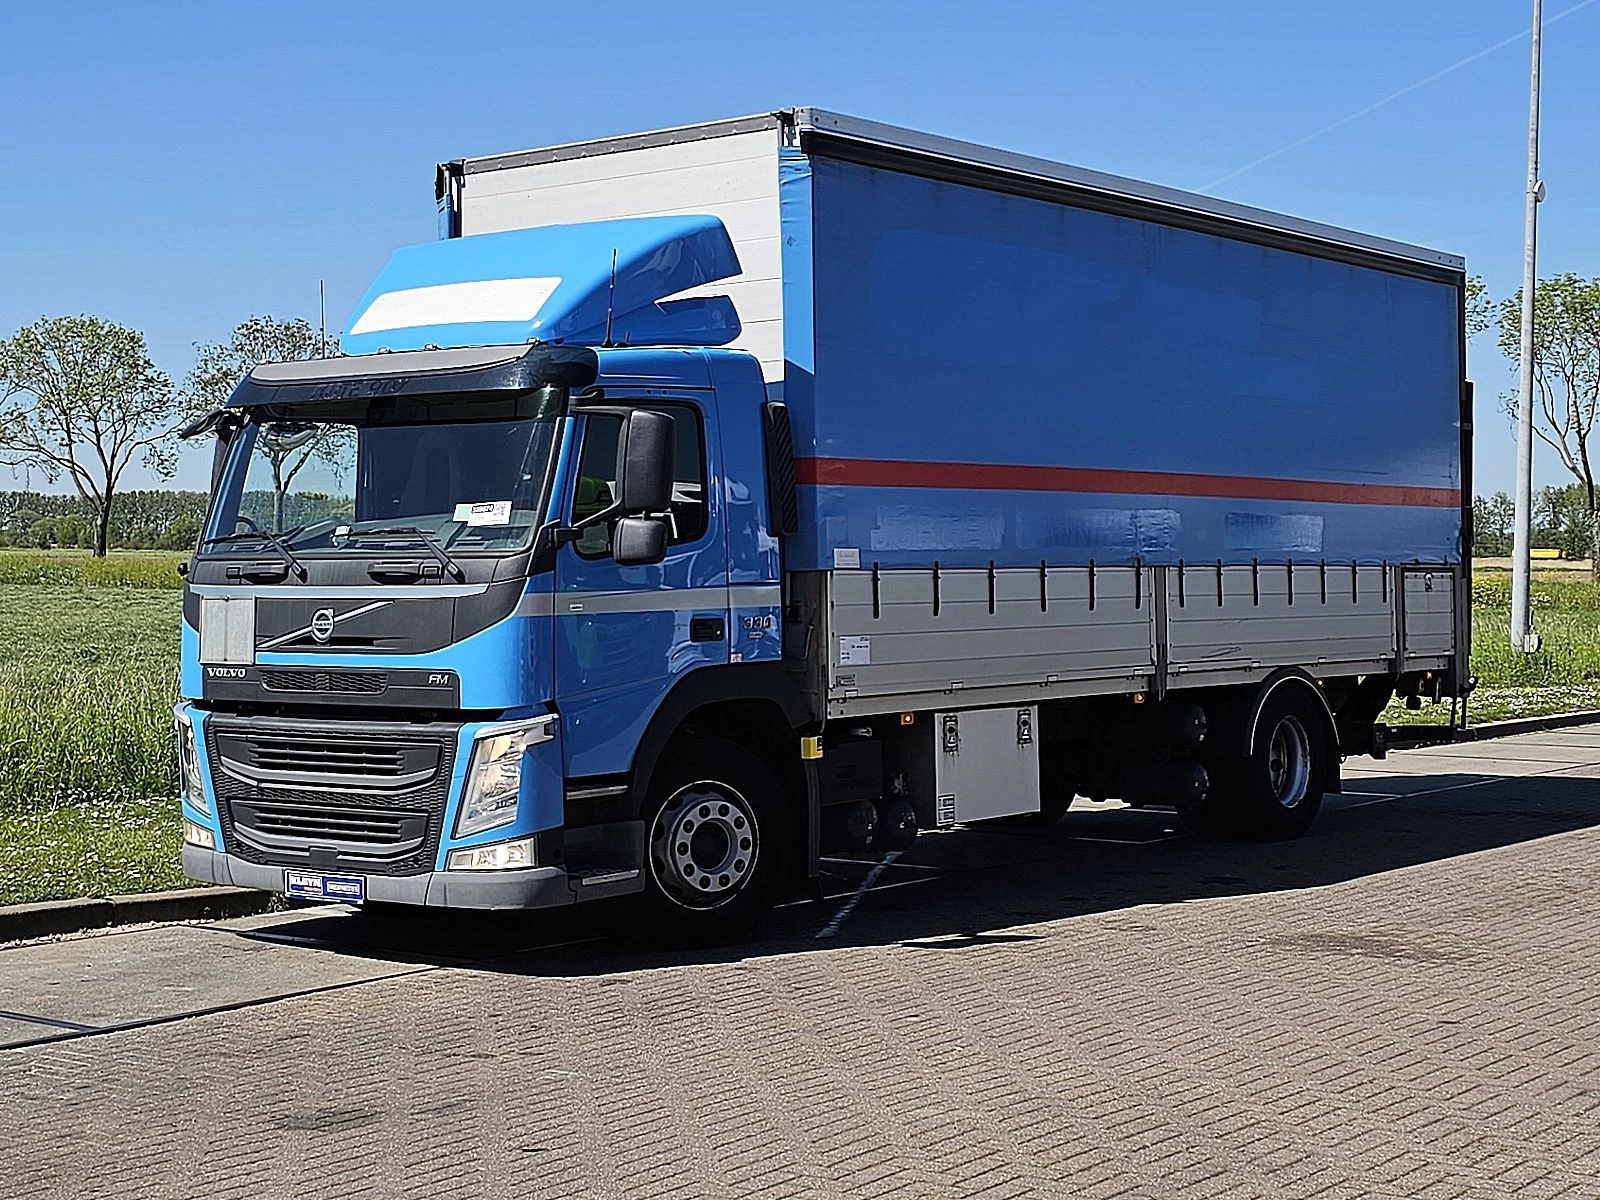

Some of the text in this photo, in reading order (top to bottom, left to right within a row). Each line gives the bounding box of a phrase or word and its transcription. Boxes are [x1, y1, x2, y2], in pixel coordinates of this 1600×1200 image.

[744, 616, 771, 629] 330
[207, 667, 246, 678] VOLVO
[428, 673, 449, 685] FM
